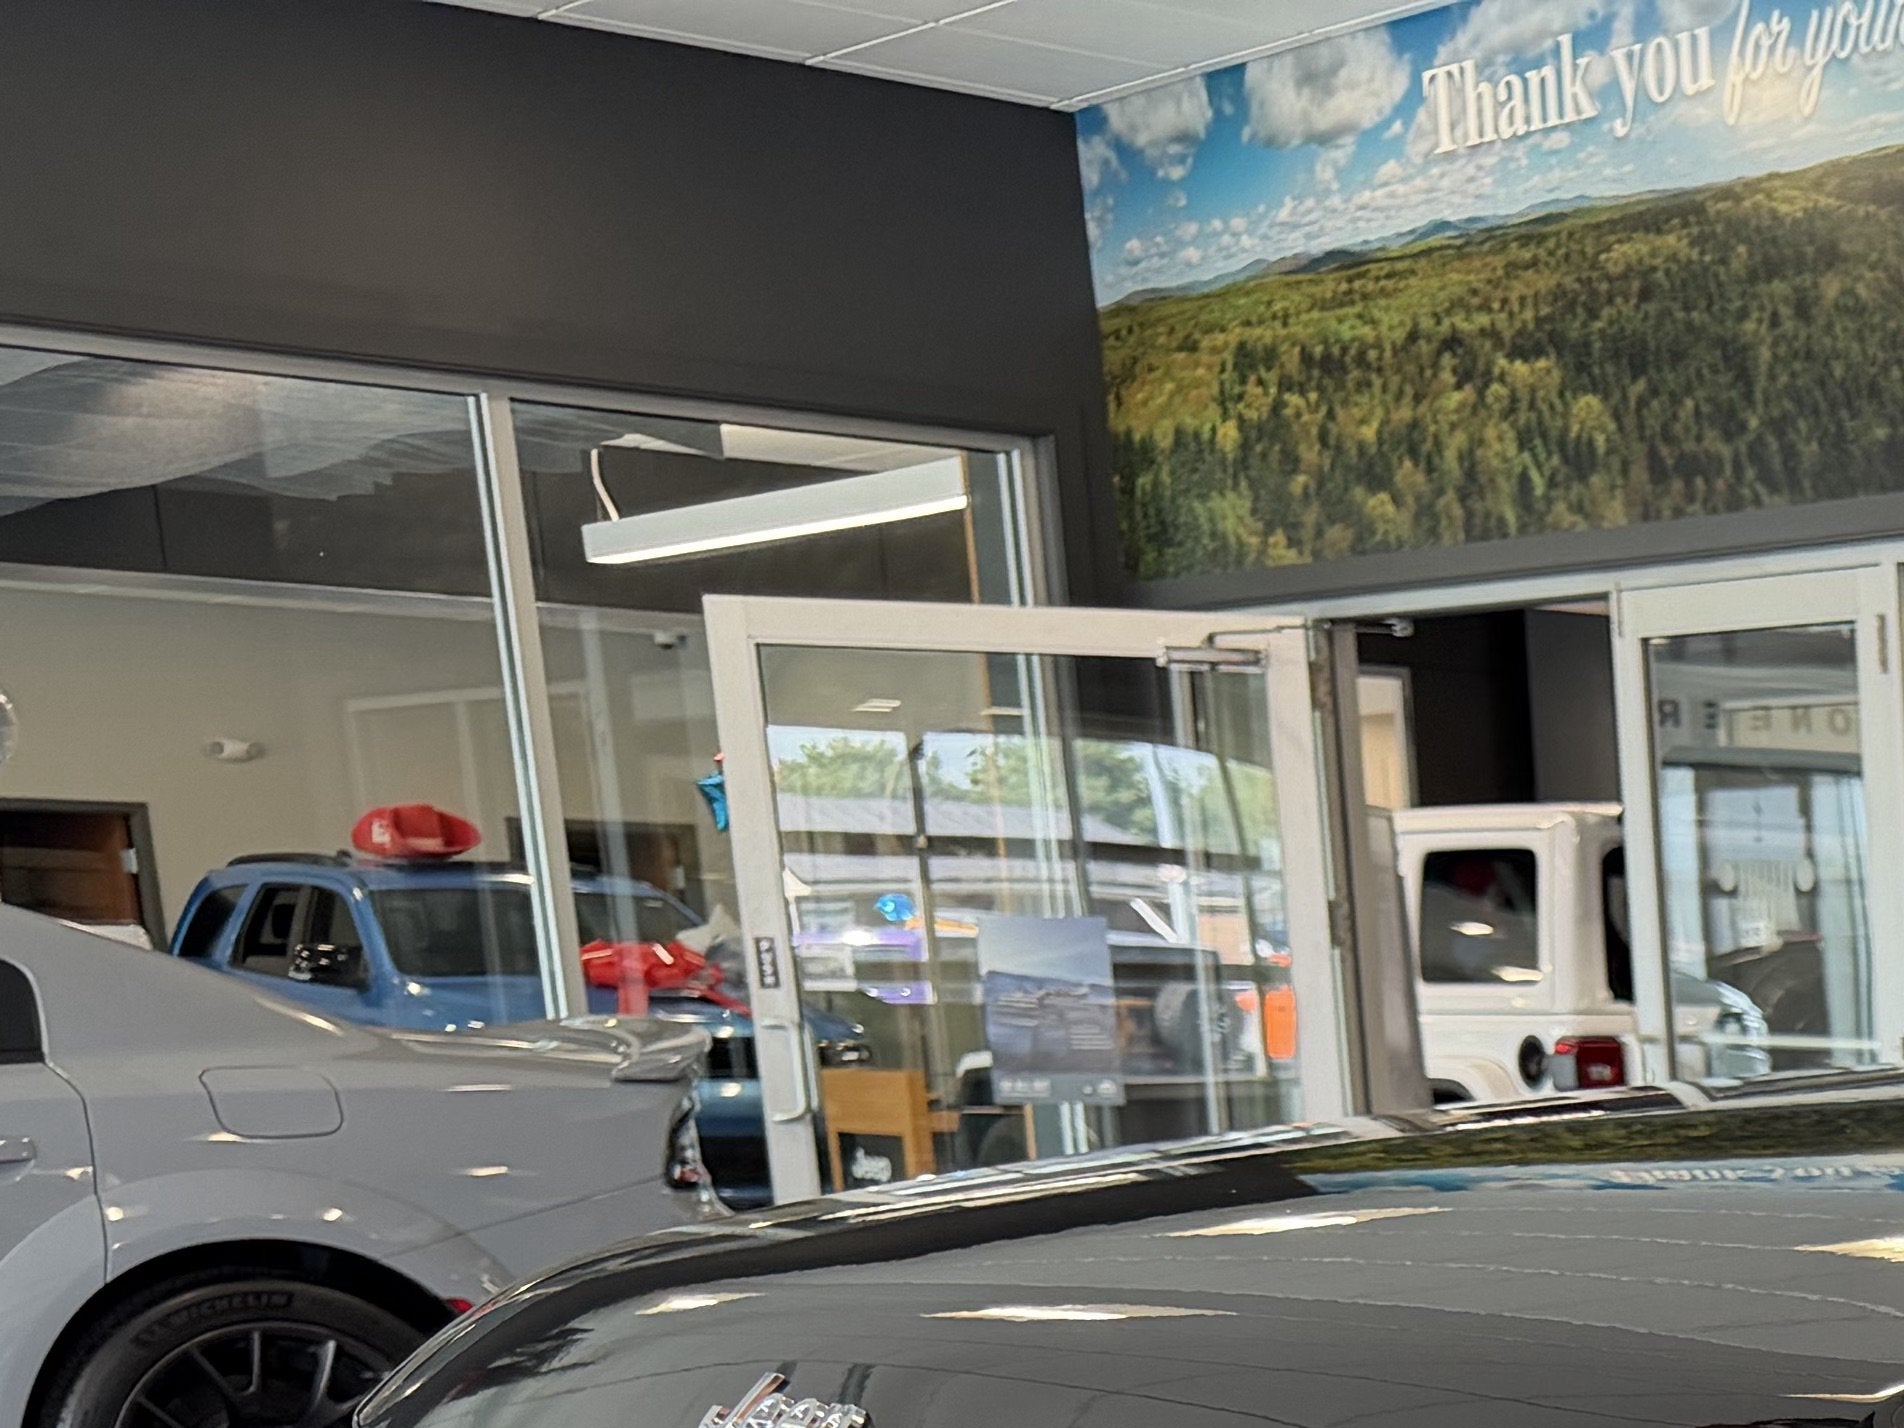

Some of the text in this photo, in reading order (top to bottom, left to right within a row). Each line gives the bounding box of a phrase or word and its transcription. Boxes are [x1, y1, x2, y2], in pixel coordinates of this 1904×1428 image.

[1421, 32, 1599, 155] Thank
[1610, 26, 1716, 138] you
[1722, 0, 1797, 126] for
